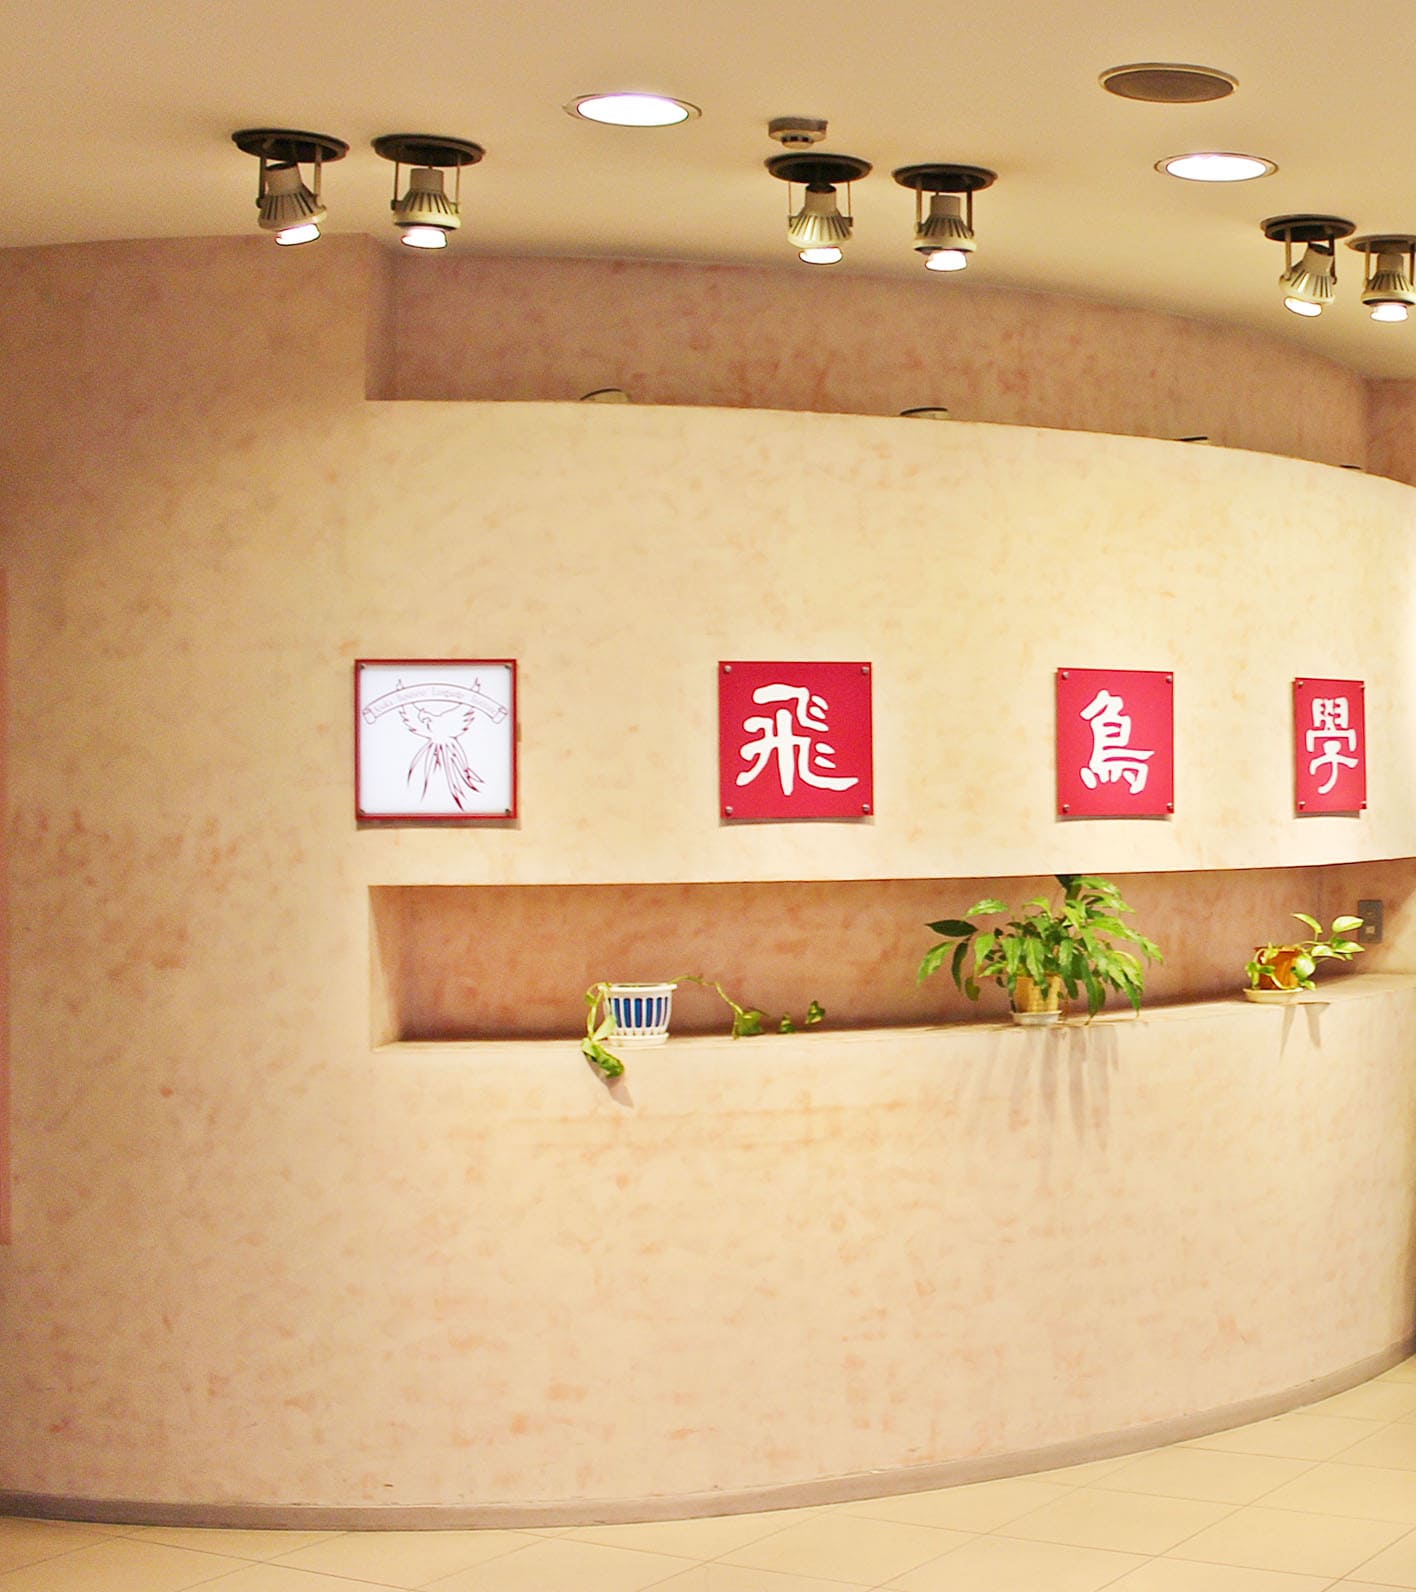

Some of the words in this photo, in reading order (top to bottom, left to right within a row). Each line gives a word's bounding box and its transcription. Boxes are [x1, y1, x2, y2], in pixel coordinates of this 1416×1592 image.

[735, 683, 859, 796] 飛
[1079, 689, 1155, 795] 鳥
[1305, 697, 1359, 795] 學
